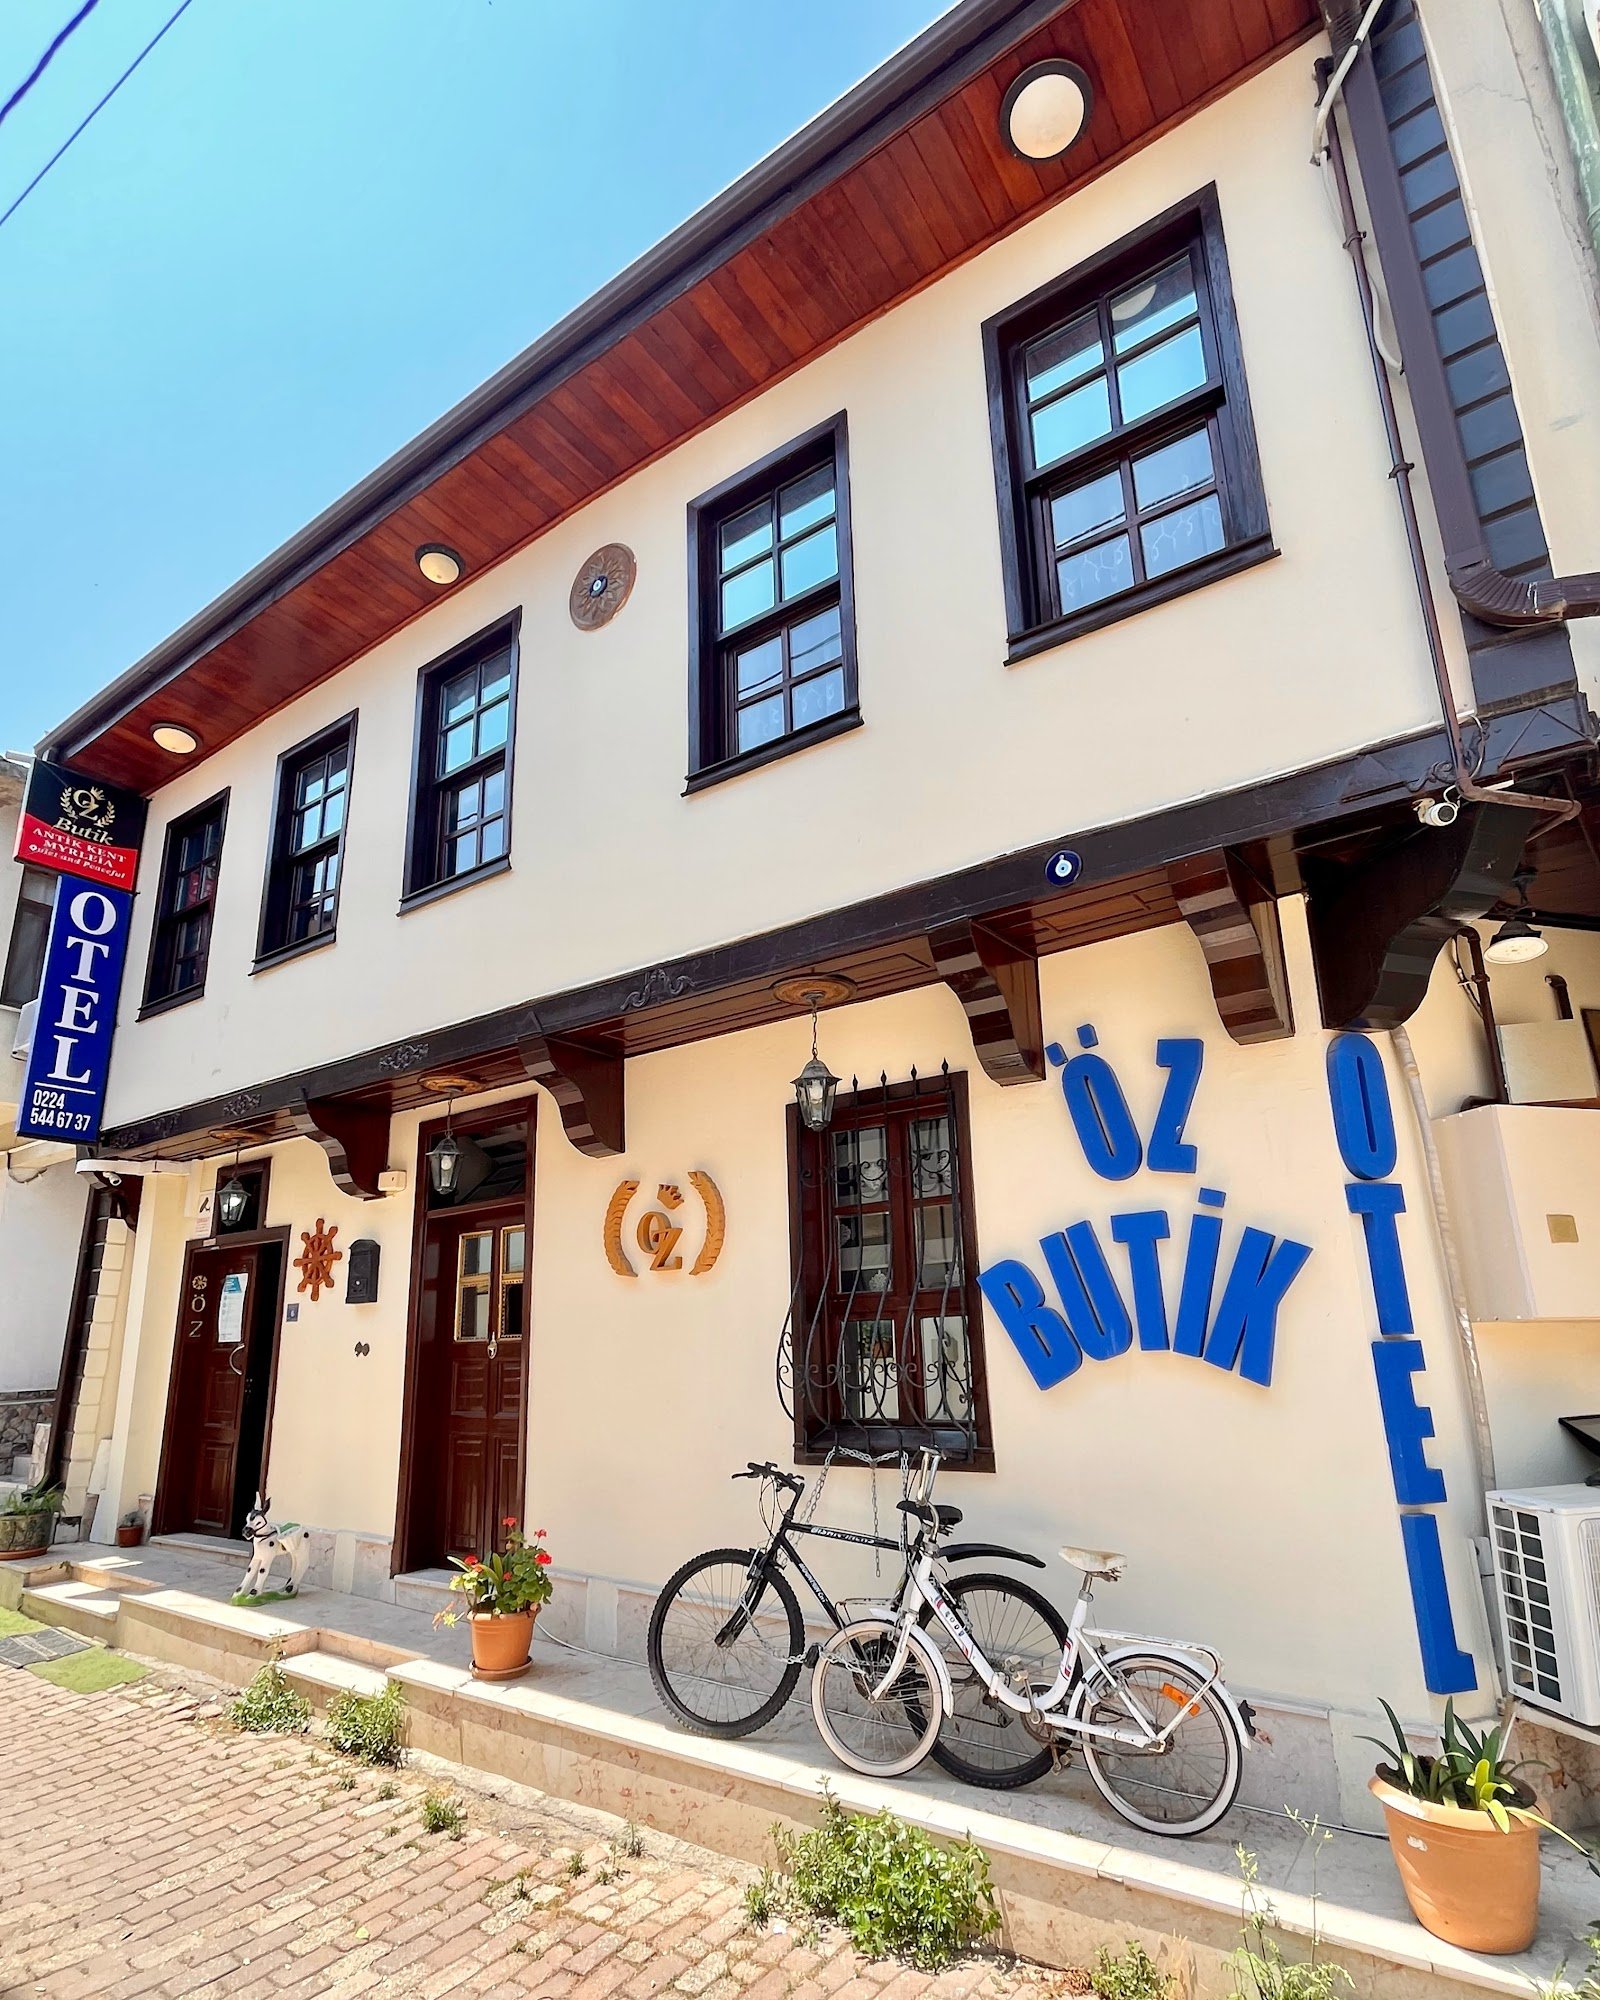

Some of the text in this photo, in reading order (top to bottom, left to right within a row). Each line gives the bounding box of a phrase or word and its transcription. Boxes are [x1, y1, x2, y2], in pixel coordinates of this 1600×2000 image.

[53, 816, 113, 846] Butik
[29, 843, 126, 879] Quiet and Peaceful
[87, 844, 127, 863] KENT
[47, 891, 117, 1084] OTEL
[33, 1089, 66, 1110] 0224
[1044, 1023, 1204, 1181] ÖZ
[30, 1107, 91, 1131] 544 67 37
[976, 1187, 1314, 1391] BUTİK
[1326, 1032, 1479, 1694] OTEL
